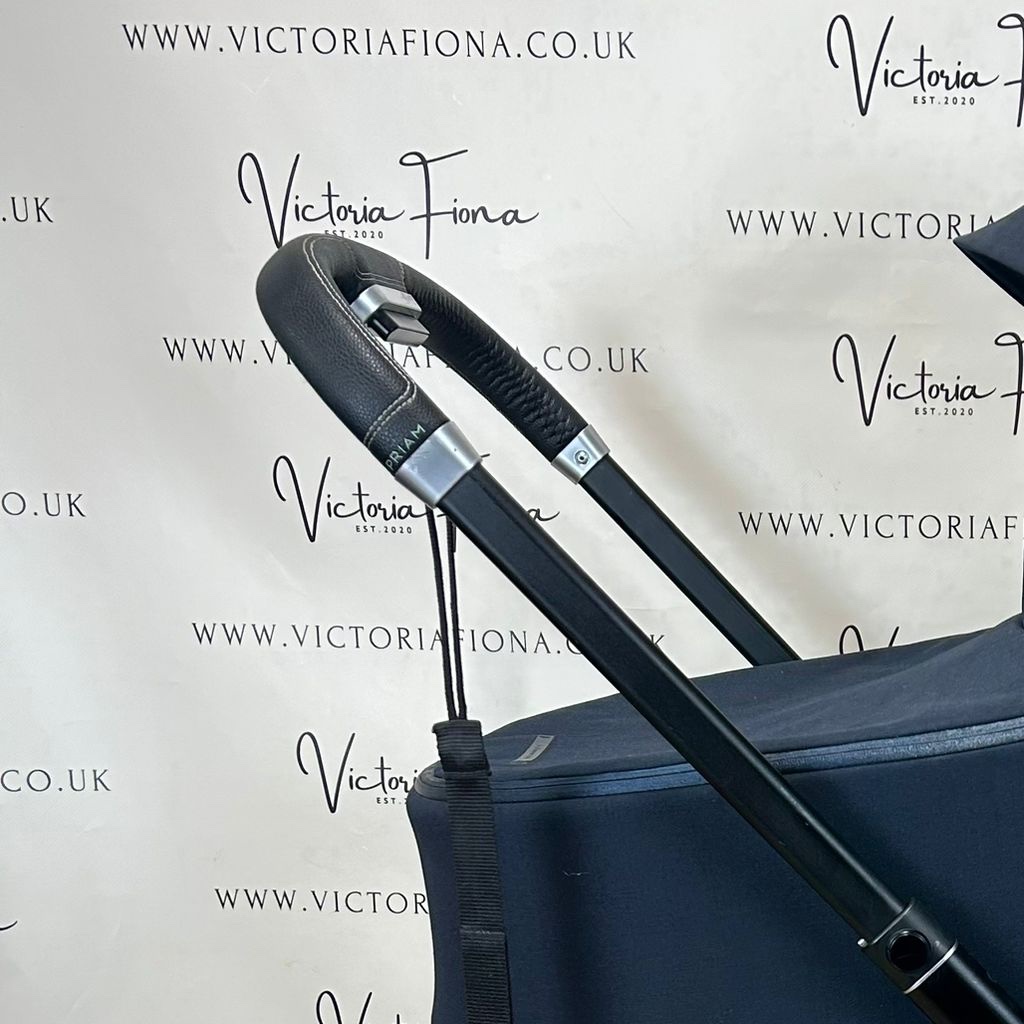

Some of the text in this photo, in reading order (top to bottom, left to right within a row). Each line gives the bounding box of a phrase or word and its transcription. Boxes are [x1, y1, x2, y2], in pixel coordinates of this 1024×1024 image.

[122, 23, 637, 60] WWW.VICTORIAFIONA.CO.UK
[826, 14, 1000, 117] Victoria
[913, 95, 976, 106] EST.2020
[238, 149, 539, 260] Victoria Fiona
[832, 333, 997, 427] Victoria
[914, 406, 974, 416] EST.2020
[385, 422, 426, 471] PRIAM
[272, 455, 430, 542] Victoria
[355, 524, 413, 535] EST.2020
[296, 731, 419, 814] Victori
